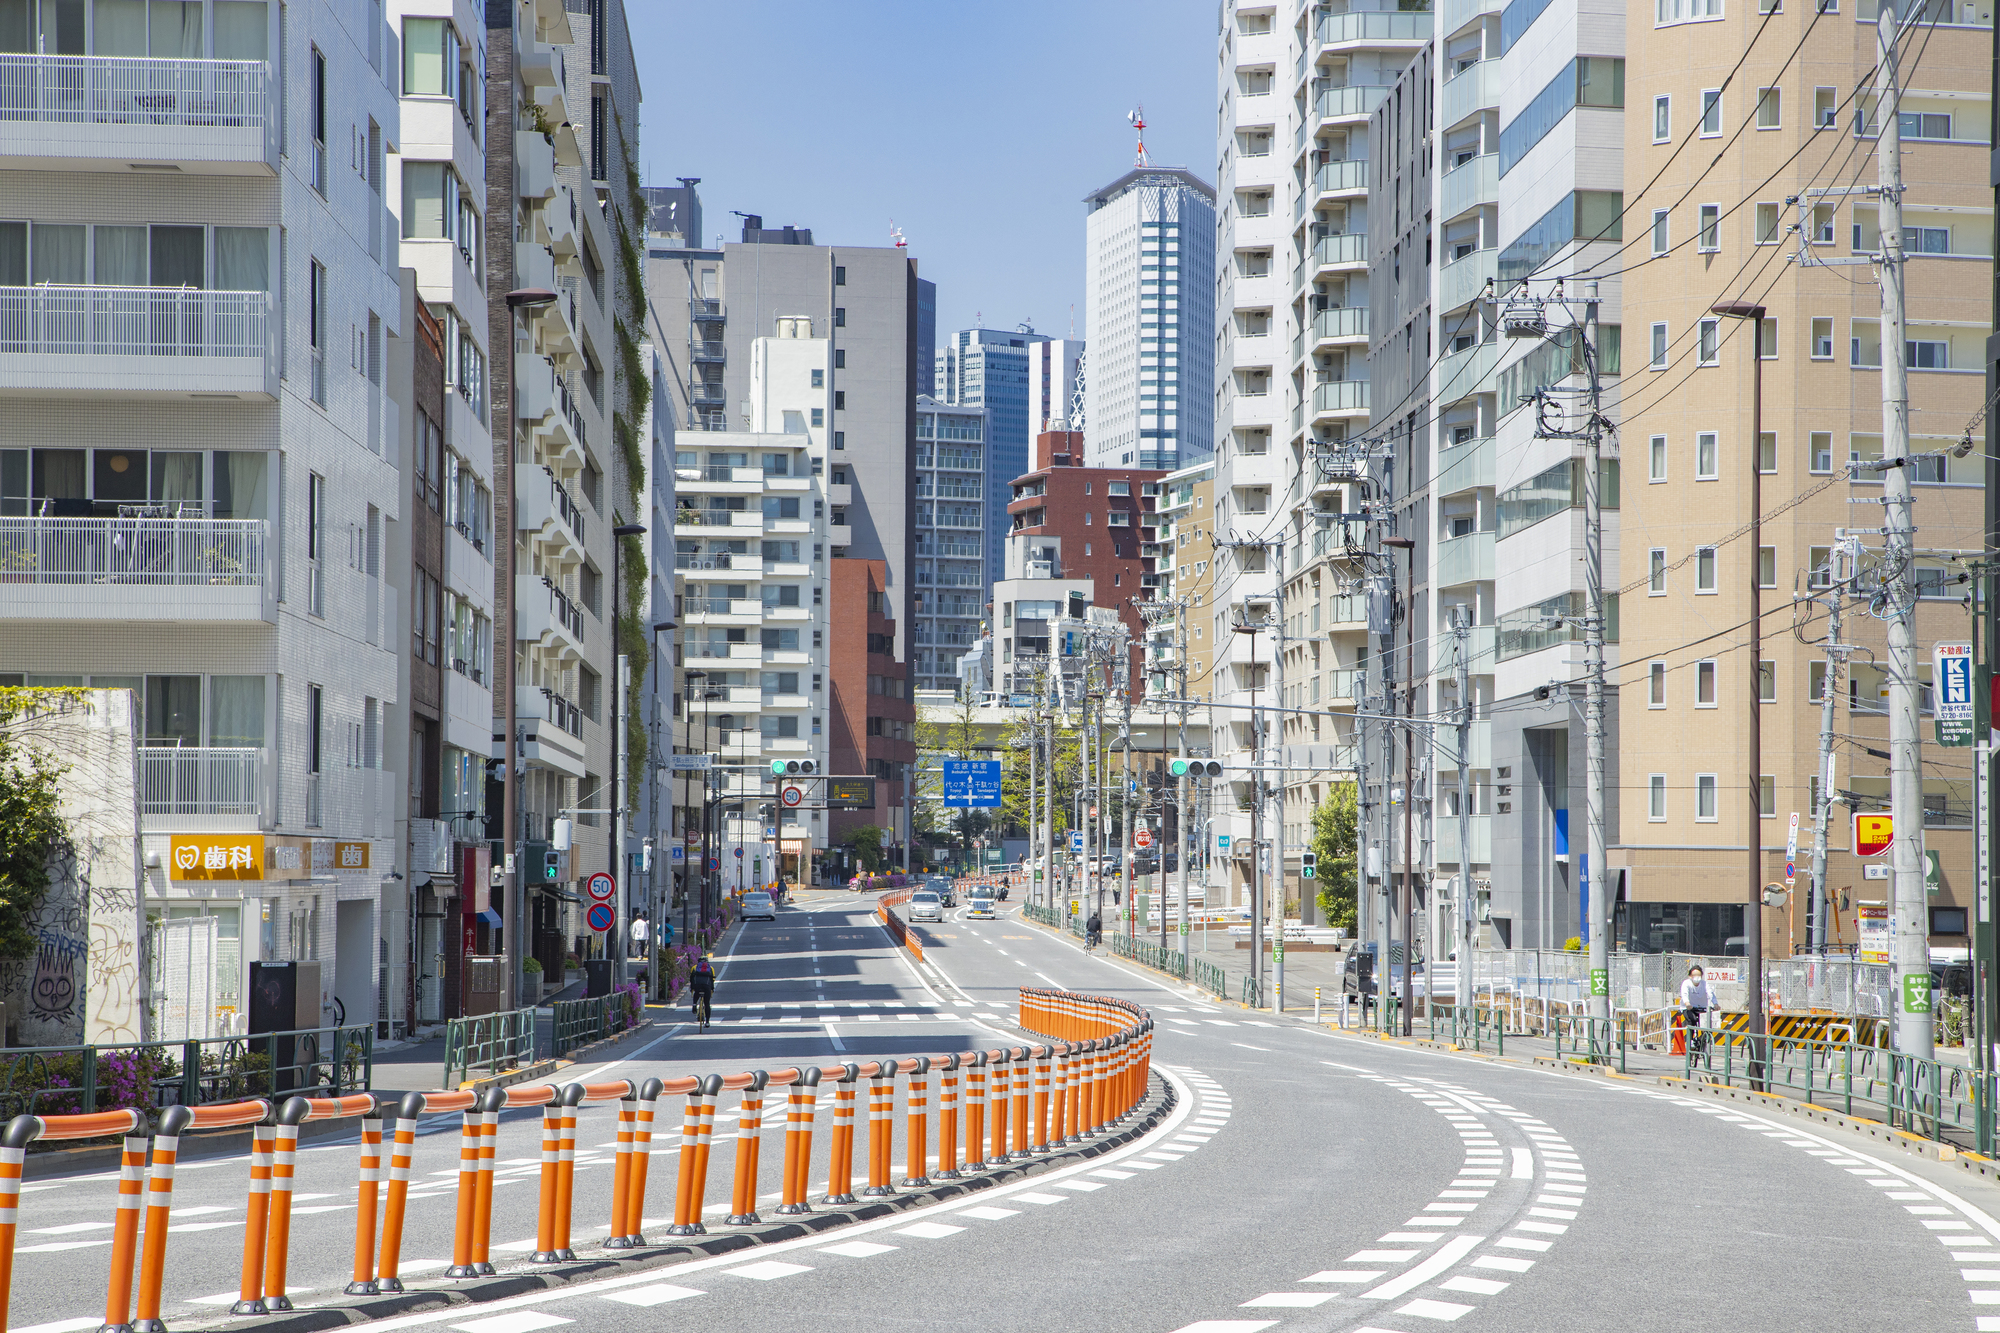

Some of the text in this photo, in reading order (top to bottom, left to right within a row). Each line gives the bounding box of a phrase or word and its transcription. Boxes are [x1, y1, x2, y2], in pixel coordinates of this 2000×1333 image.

[1939, 646, 1971, 655] 不動産は
[1947, 659, 1965, 702] KEN
[786, 791, 798, 801] 50
[204, 845, 253, 869] 歯科
[341, 844, 363, 866] 歯
[592, 880, 609, 893] 50
[1707, 971, 1736, 981] 立入禁止
[1594, 977, 1607, 991] 文
[1910, 985, 1929, 1006] 文
